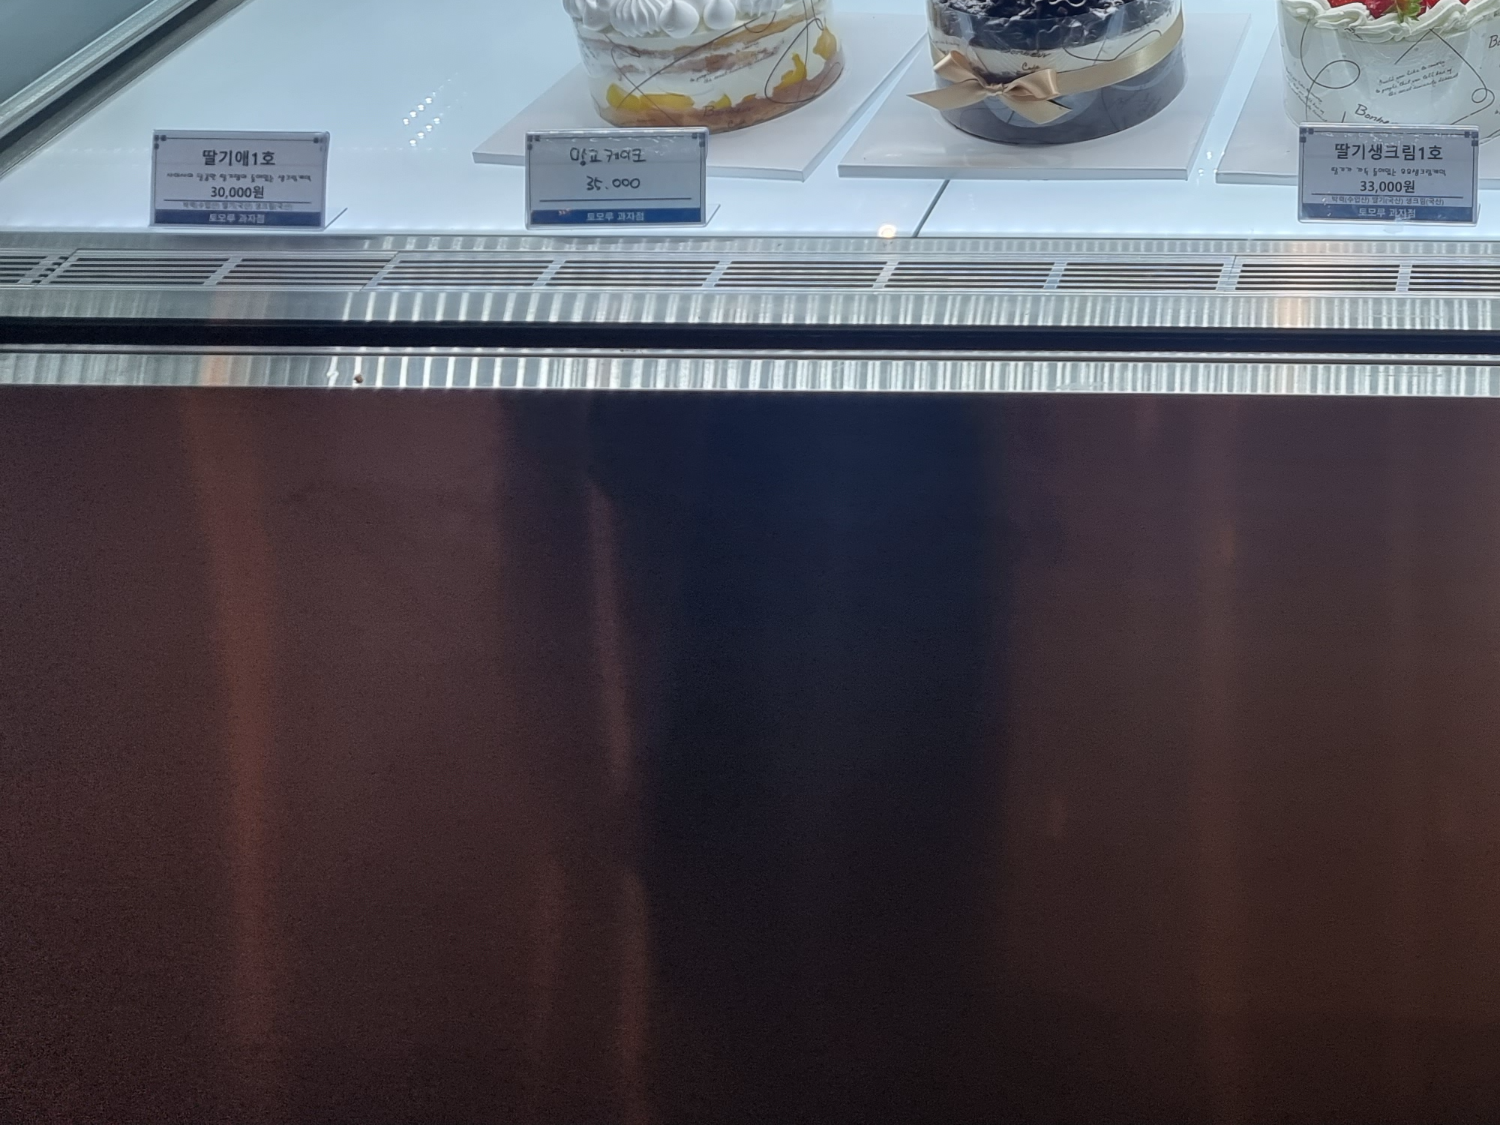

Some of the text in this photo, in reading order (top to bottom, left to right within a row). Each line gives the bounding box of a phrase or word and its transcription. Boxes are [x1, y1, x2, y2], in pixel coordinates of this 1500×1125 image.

[202, 149, 276, 167] 딸기애1호
[1334, 143, 1443, 161] 딸기생크림1호
[210, 186, 265, 200] 30,000원
[1360, 180, 1415, 194] 33,000원
[617, 211, 645, 221] 과자점
[1389, 208, 1416, 218] 과자점
